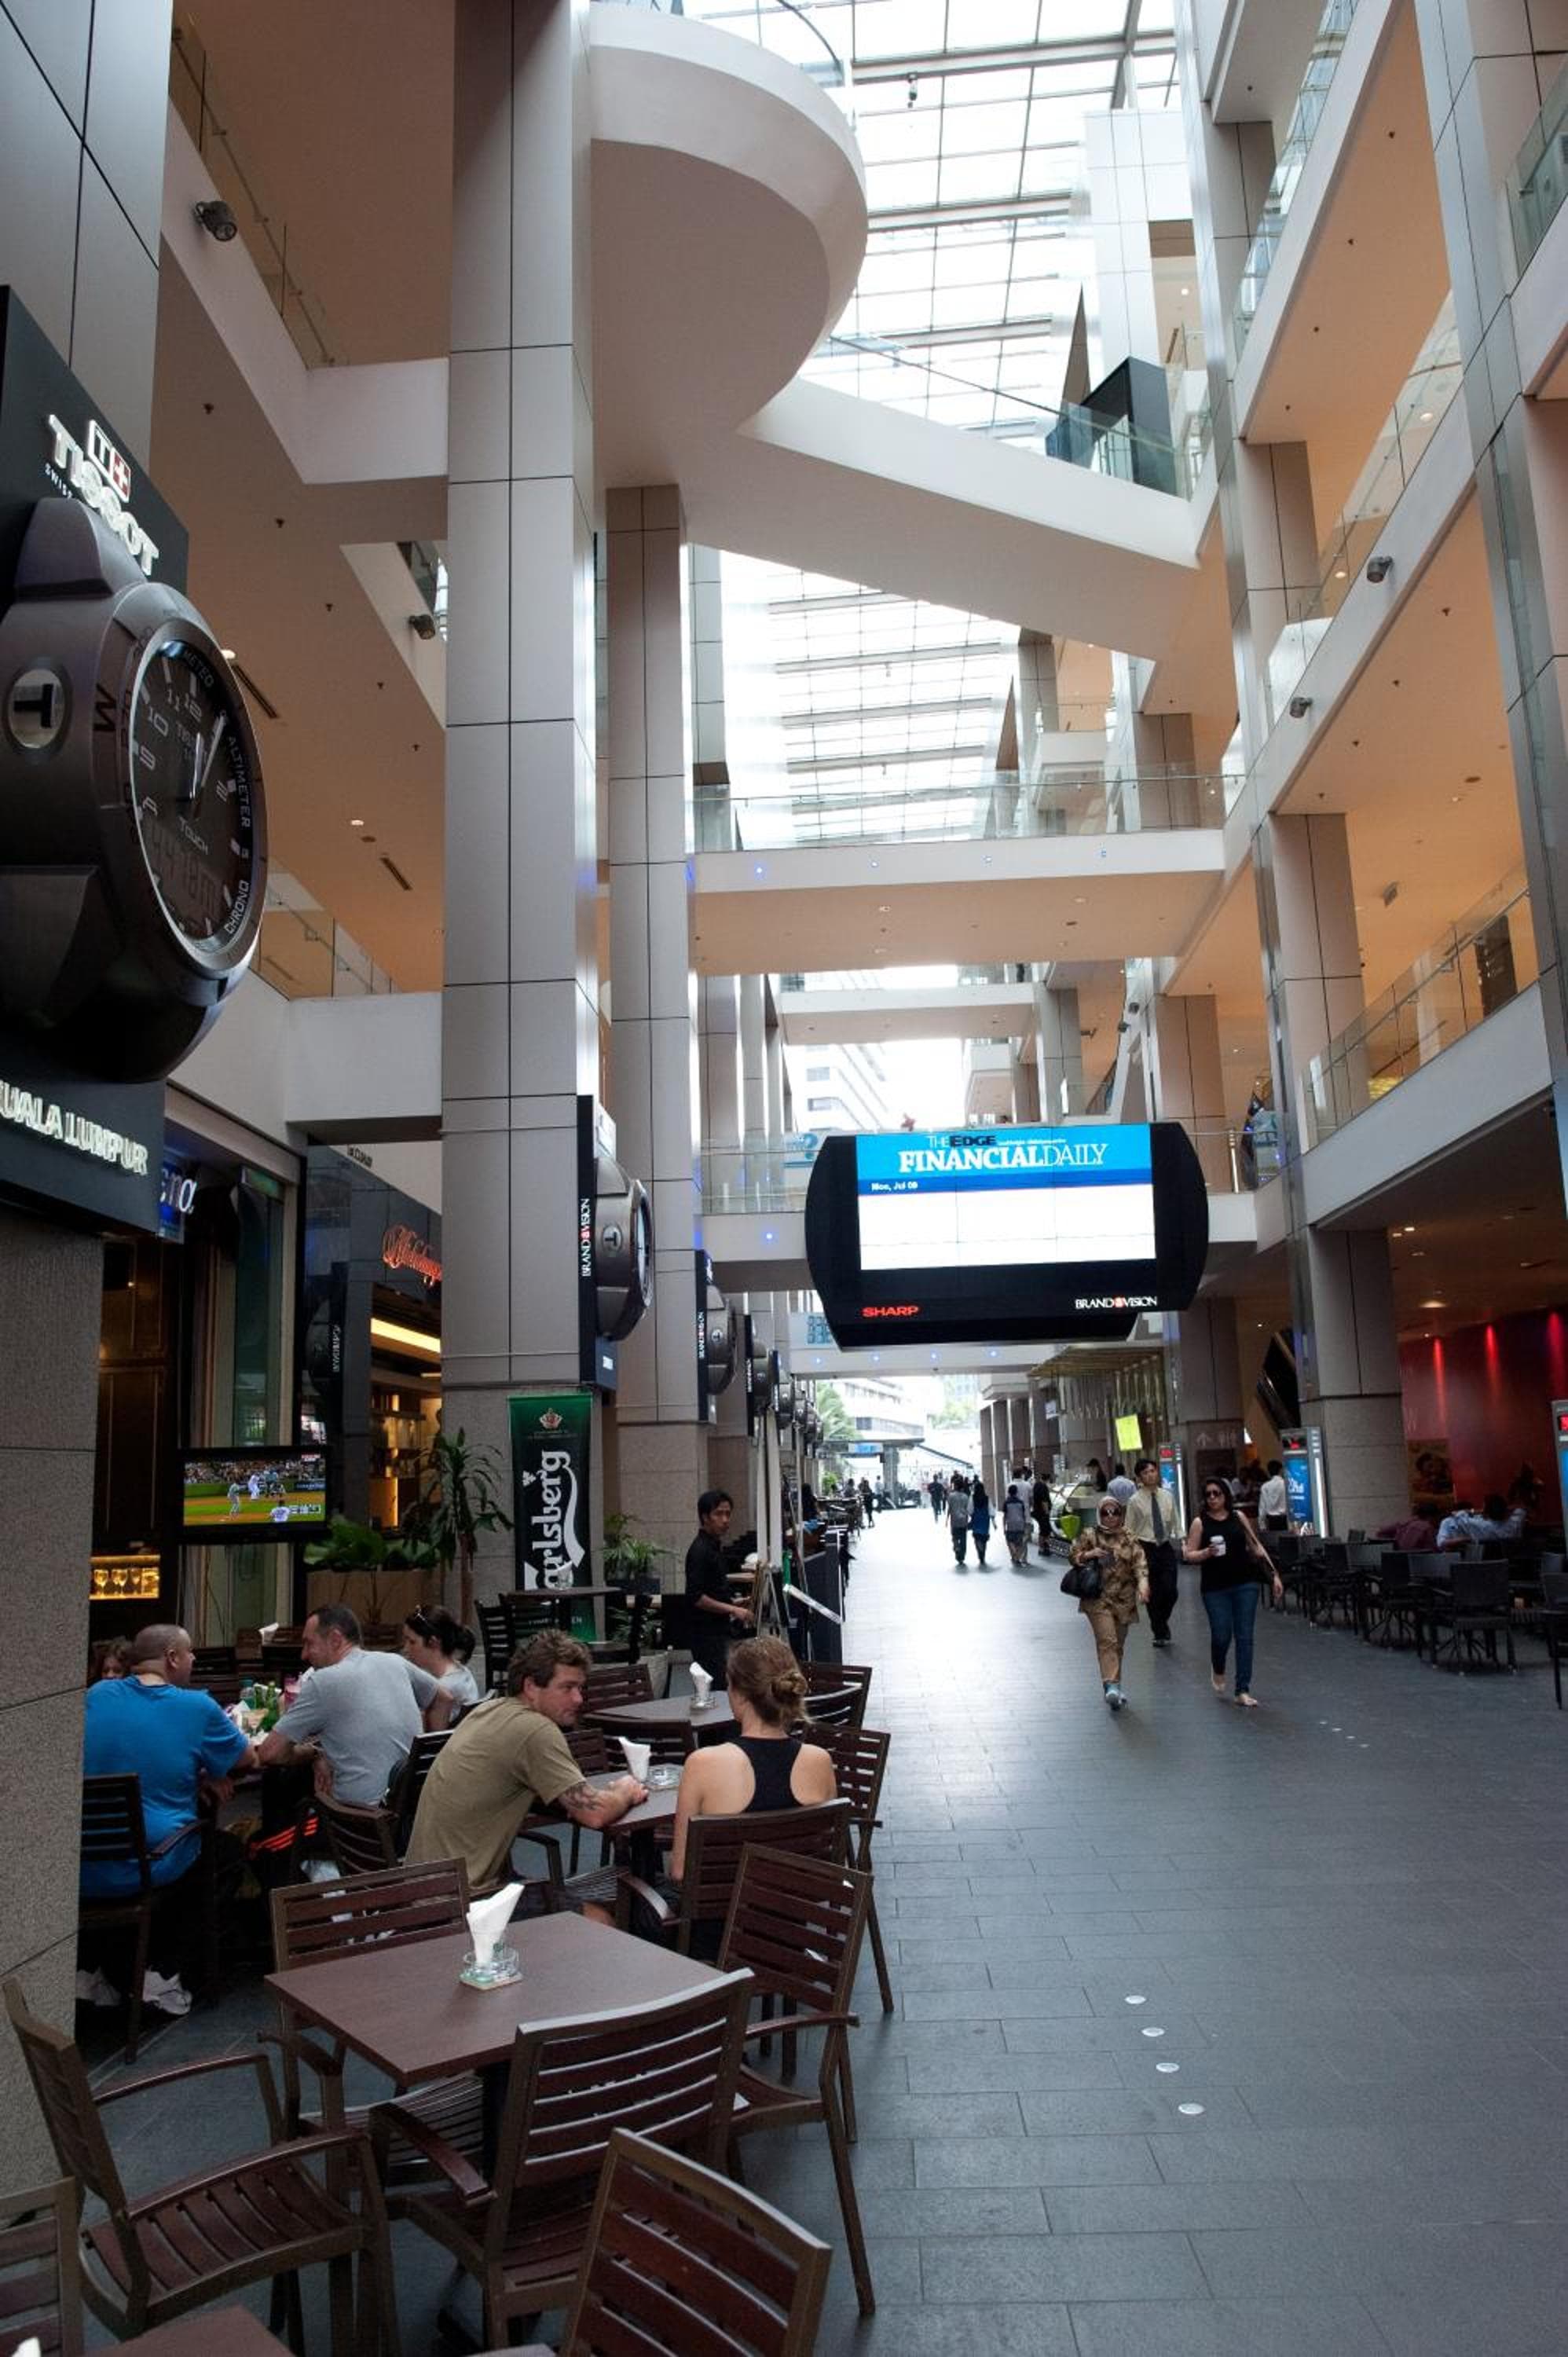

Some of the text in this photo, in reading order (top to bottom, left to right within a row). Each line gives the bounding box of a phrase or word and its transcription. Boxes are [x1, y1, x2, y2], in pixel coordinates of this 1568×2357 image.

[49, 414, 159, 576] TISSOT
[185, 649, 214, 687] METEO
[148, 708, 169, 737] 10
[229, 735, 251, 828] ALTIMETER
[224, 879, 250, 933] CHRONO
[0, 1079, 148, 1175] UALA LUMPUR
[862, 1306, 920, 1318] SHARP
